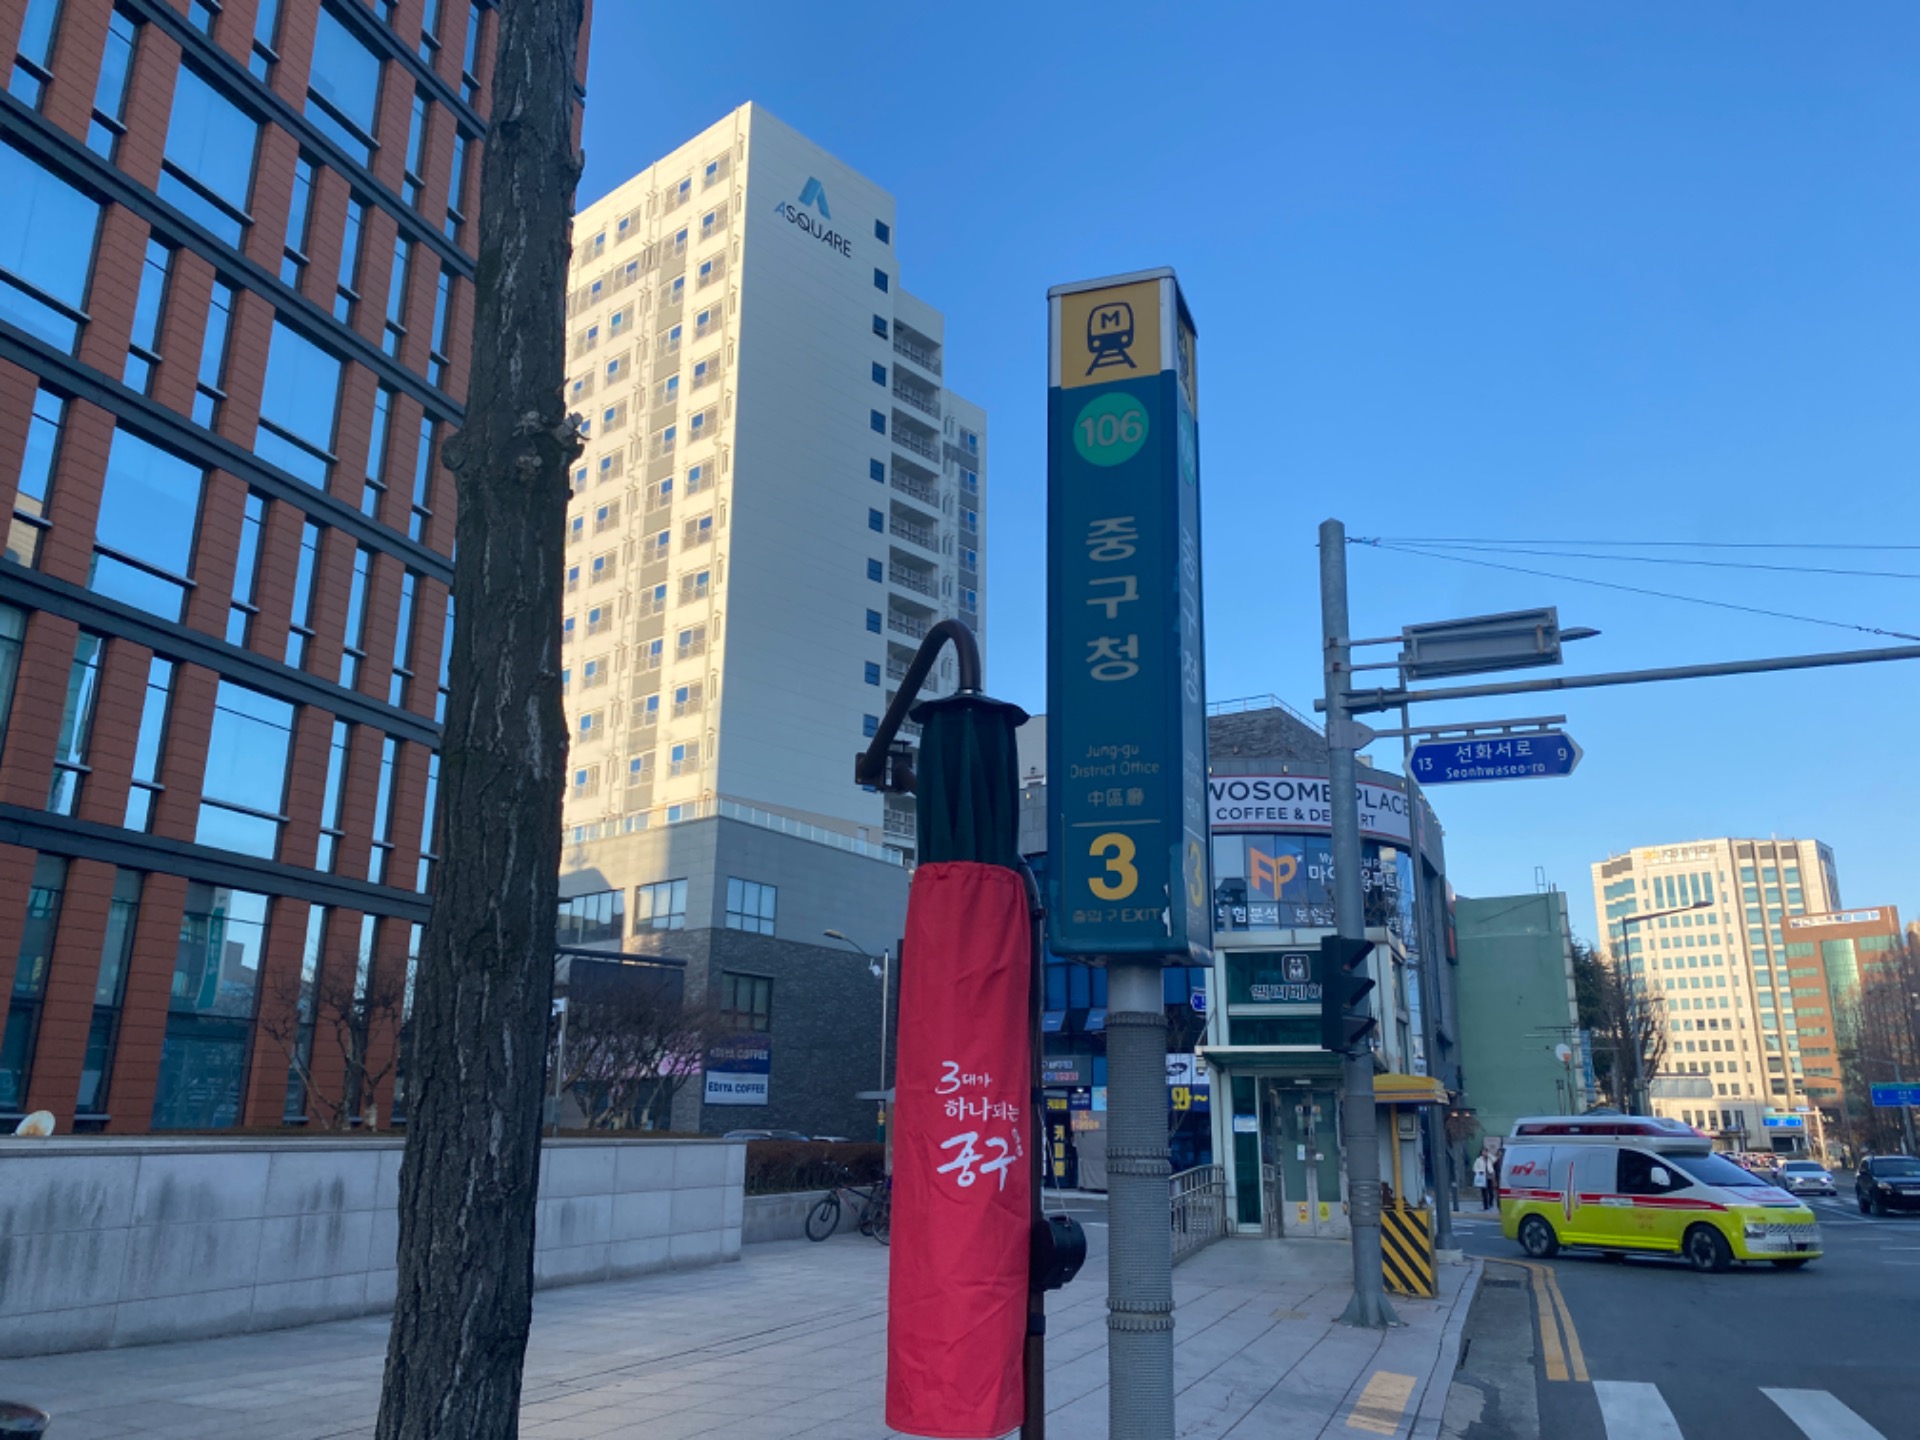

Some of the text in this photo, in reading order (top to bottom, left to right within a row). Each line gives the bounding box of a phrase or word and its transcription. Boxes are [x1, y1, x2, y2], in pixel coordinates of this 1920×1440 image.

[1080, 409, 1144, 448] 106
[1085, 516, 1140, 682] 중구청
[1086, 744, 1139, 760] Jung-gu
[1455, 740, 1534, 764] 선화서로
[1557, 748, 1568, 761] 9
[1070, 759, 1160, 779] District Office
[1417, 758, 1434, 771] 13
[1445, 763, 1546, 780] Seonhwaseo-ro
[1216, 806, 1288, 820] COFFEE
[1294, 809, 1304, 821] &
[1087, 832, 1139, 901] 3
[1188, 839, 1203, 908] 3
[1121, 907, 1161, 922] EXIT
[735, 1083, 766, 1094] COFFEE
[936, 1131, 1017, 1192] 중구
